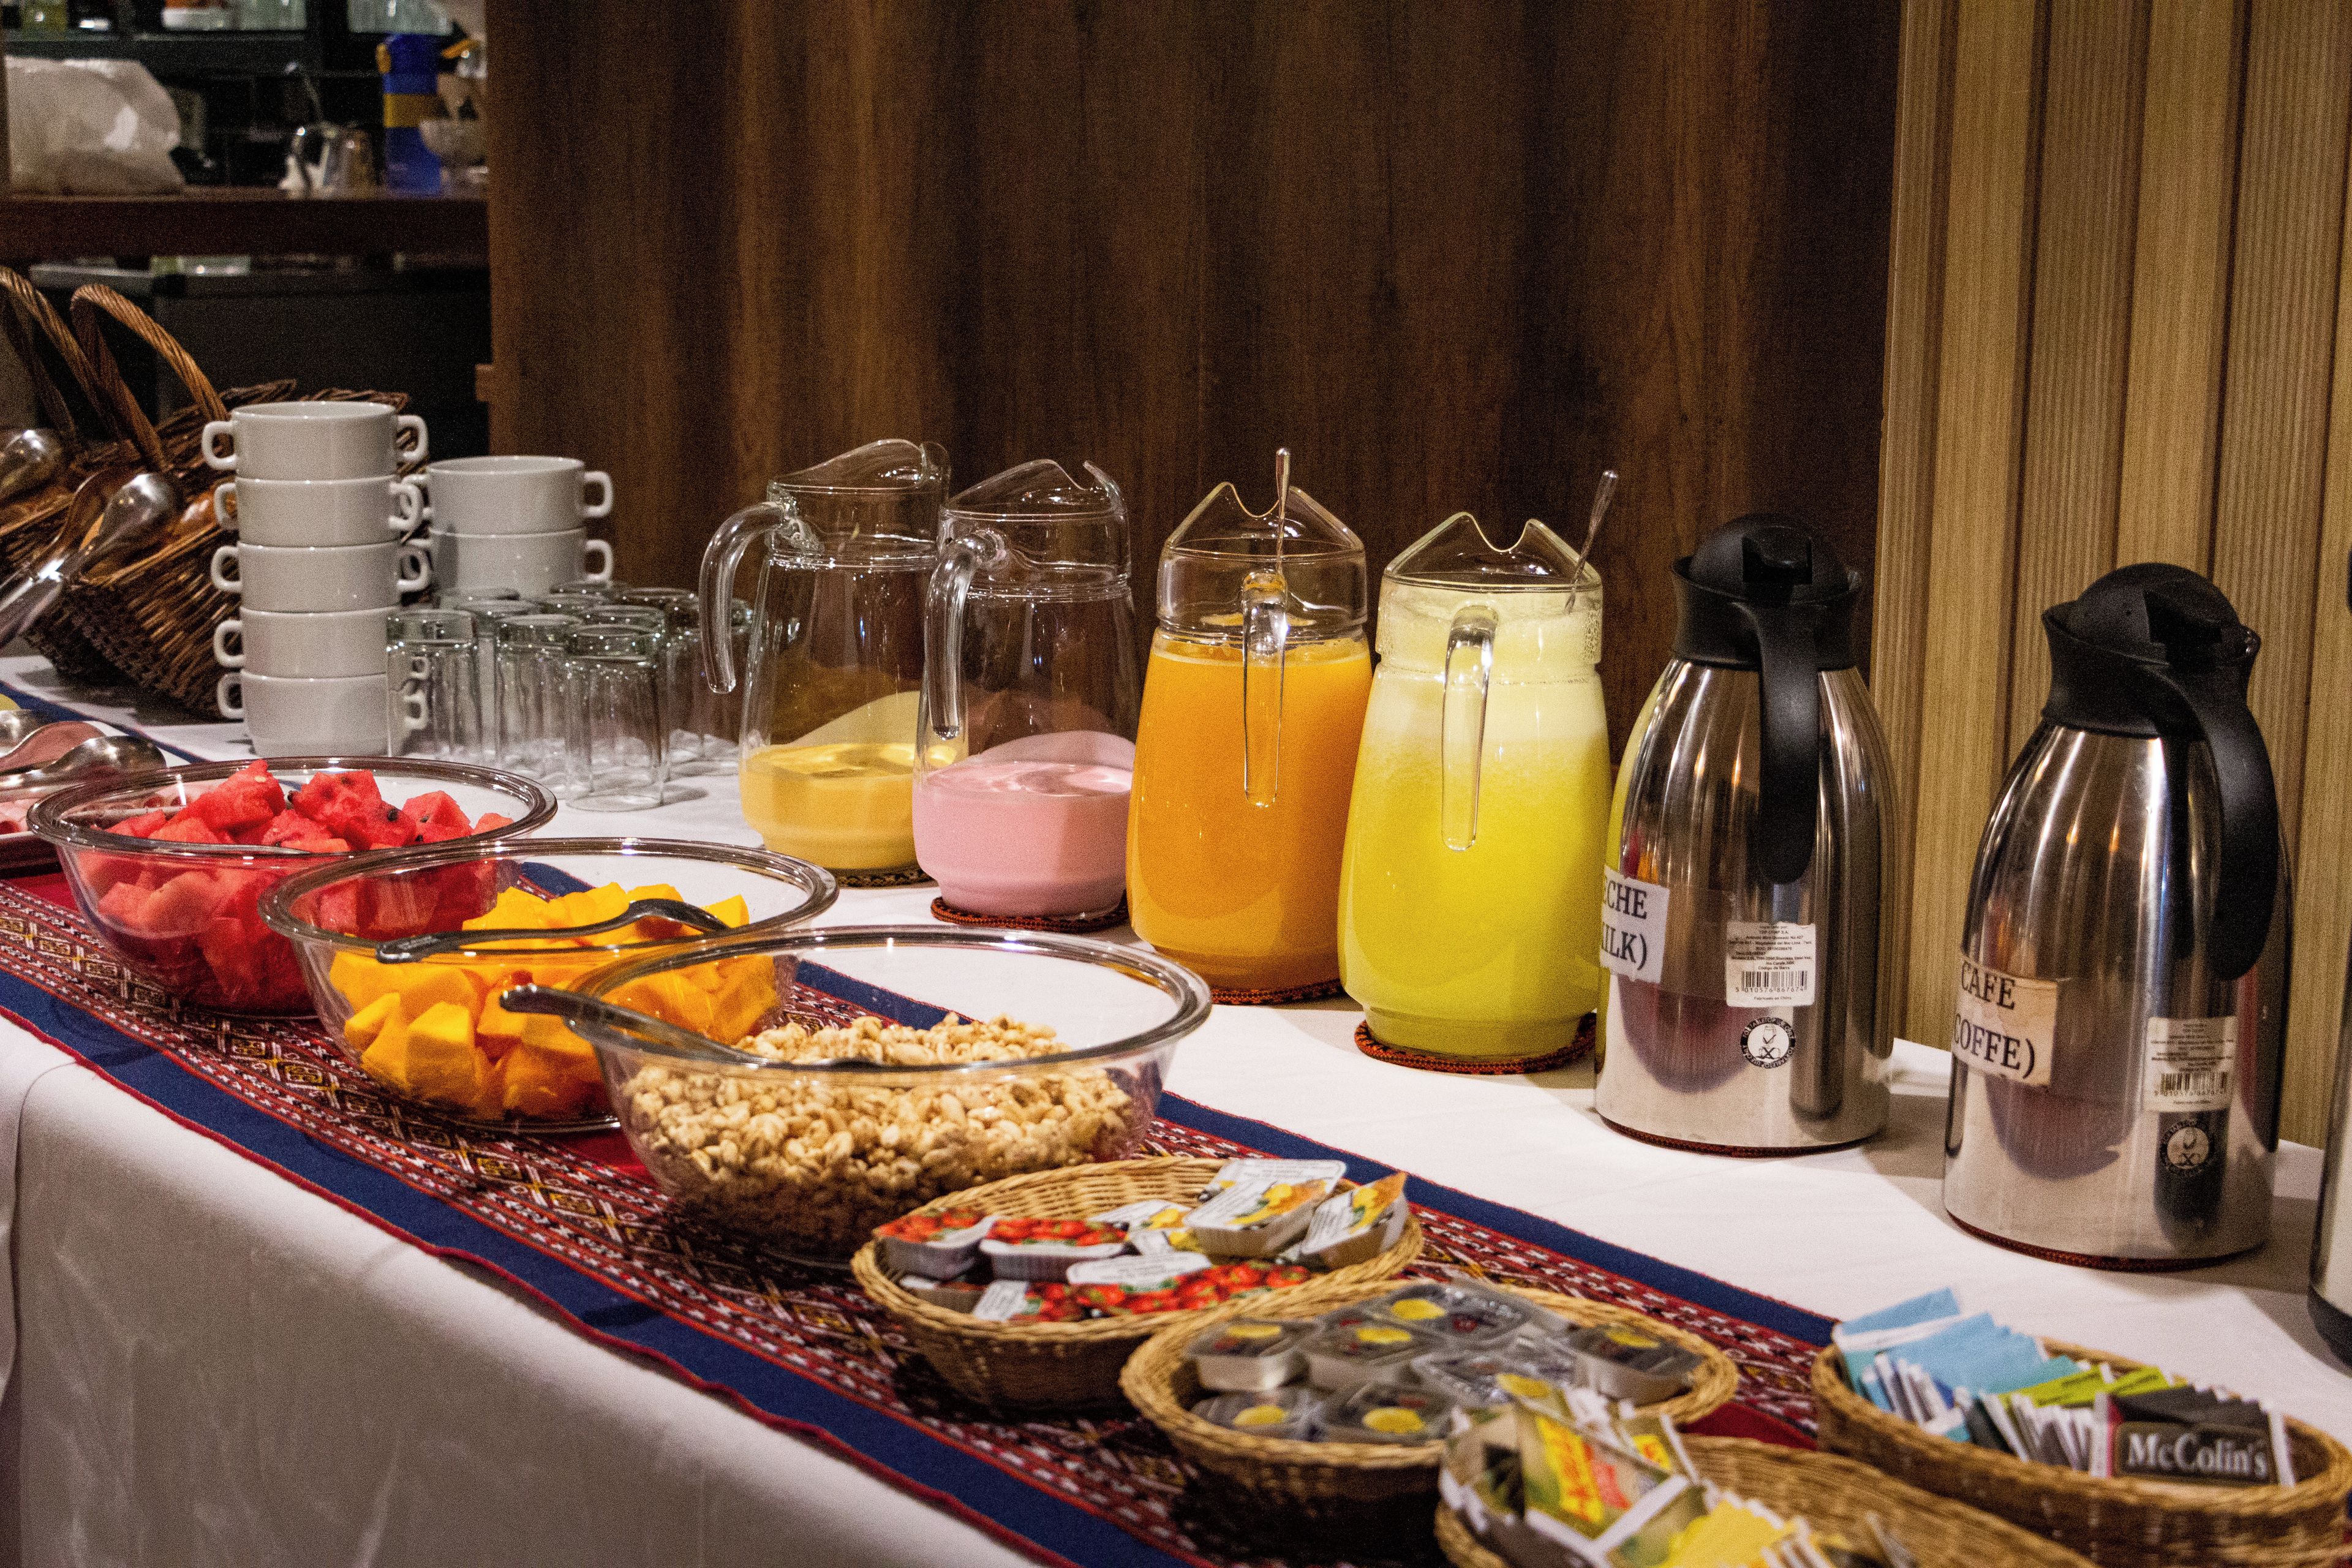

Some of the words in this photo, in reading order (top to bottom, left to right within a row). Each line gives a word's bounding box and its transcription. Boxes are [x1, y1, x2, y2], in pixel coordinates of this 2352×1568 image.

[1605, 880, 1648, 919] CHE
[1961, 960, 2016, 1010] CAFE
[2127, 1432, 2267, 1478] McColin's
